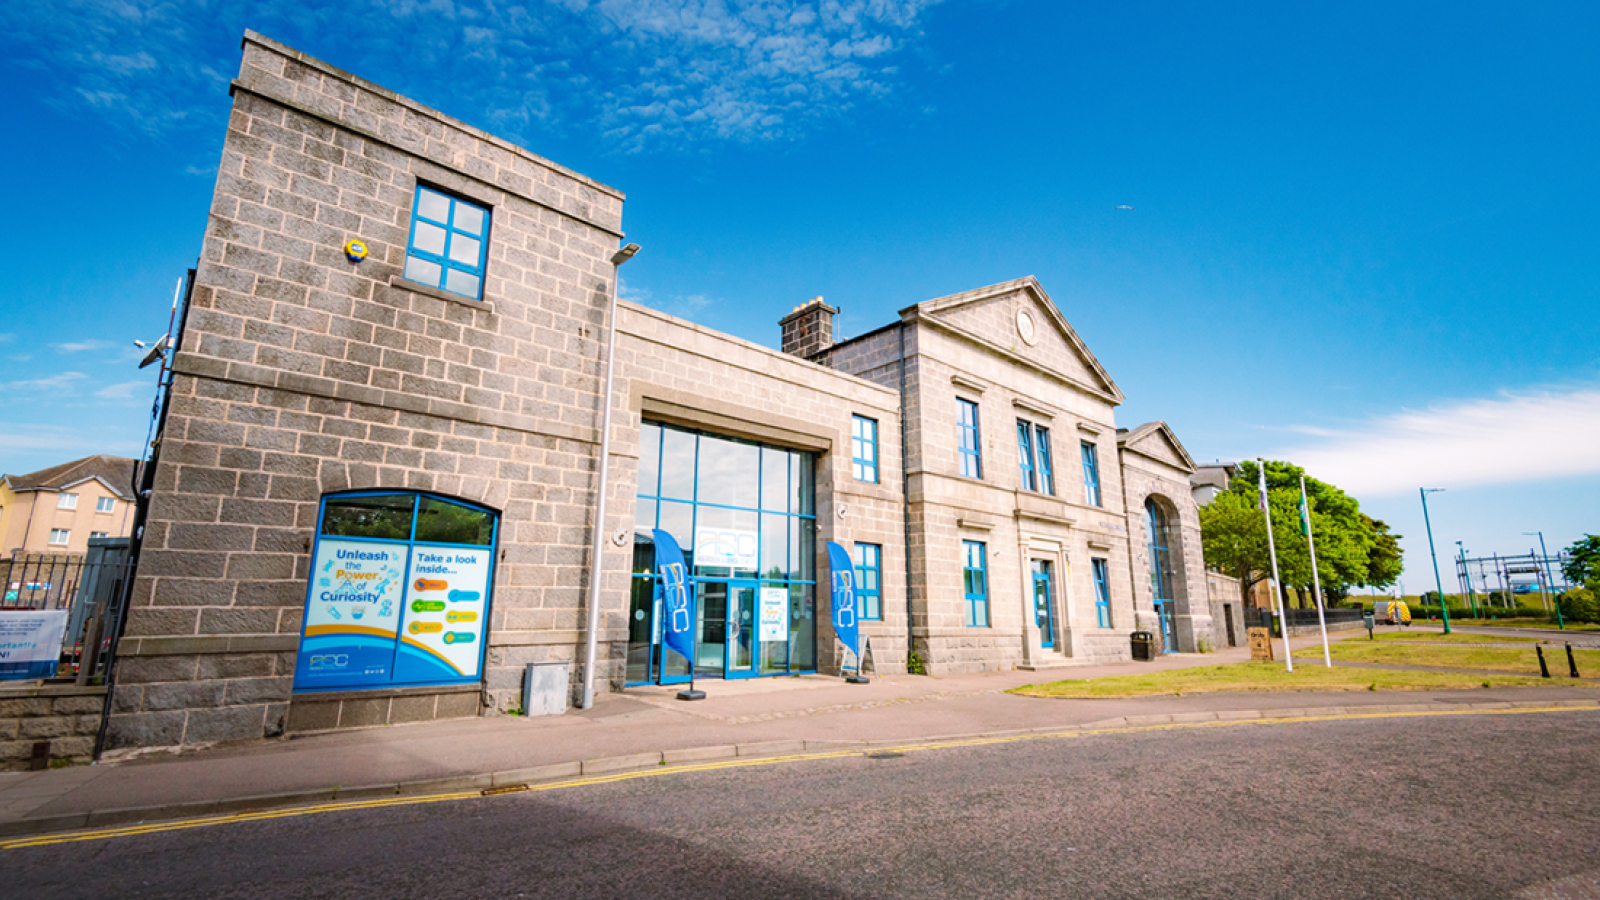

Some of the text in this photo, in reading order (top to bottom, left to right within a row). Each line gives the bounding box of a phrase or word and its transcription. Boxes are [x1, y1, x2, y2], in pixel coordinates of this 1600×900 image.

[336, 549, 389, 561] Unleash
[417, 553, 477, 564] Take a look
[345, 561, 362, 570] the
[415, 563, 458, 574] inside...
[356, 581, 367, 590] of
[320, 591, 381, 605] Curiosity
